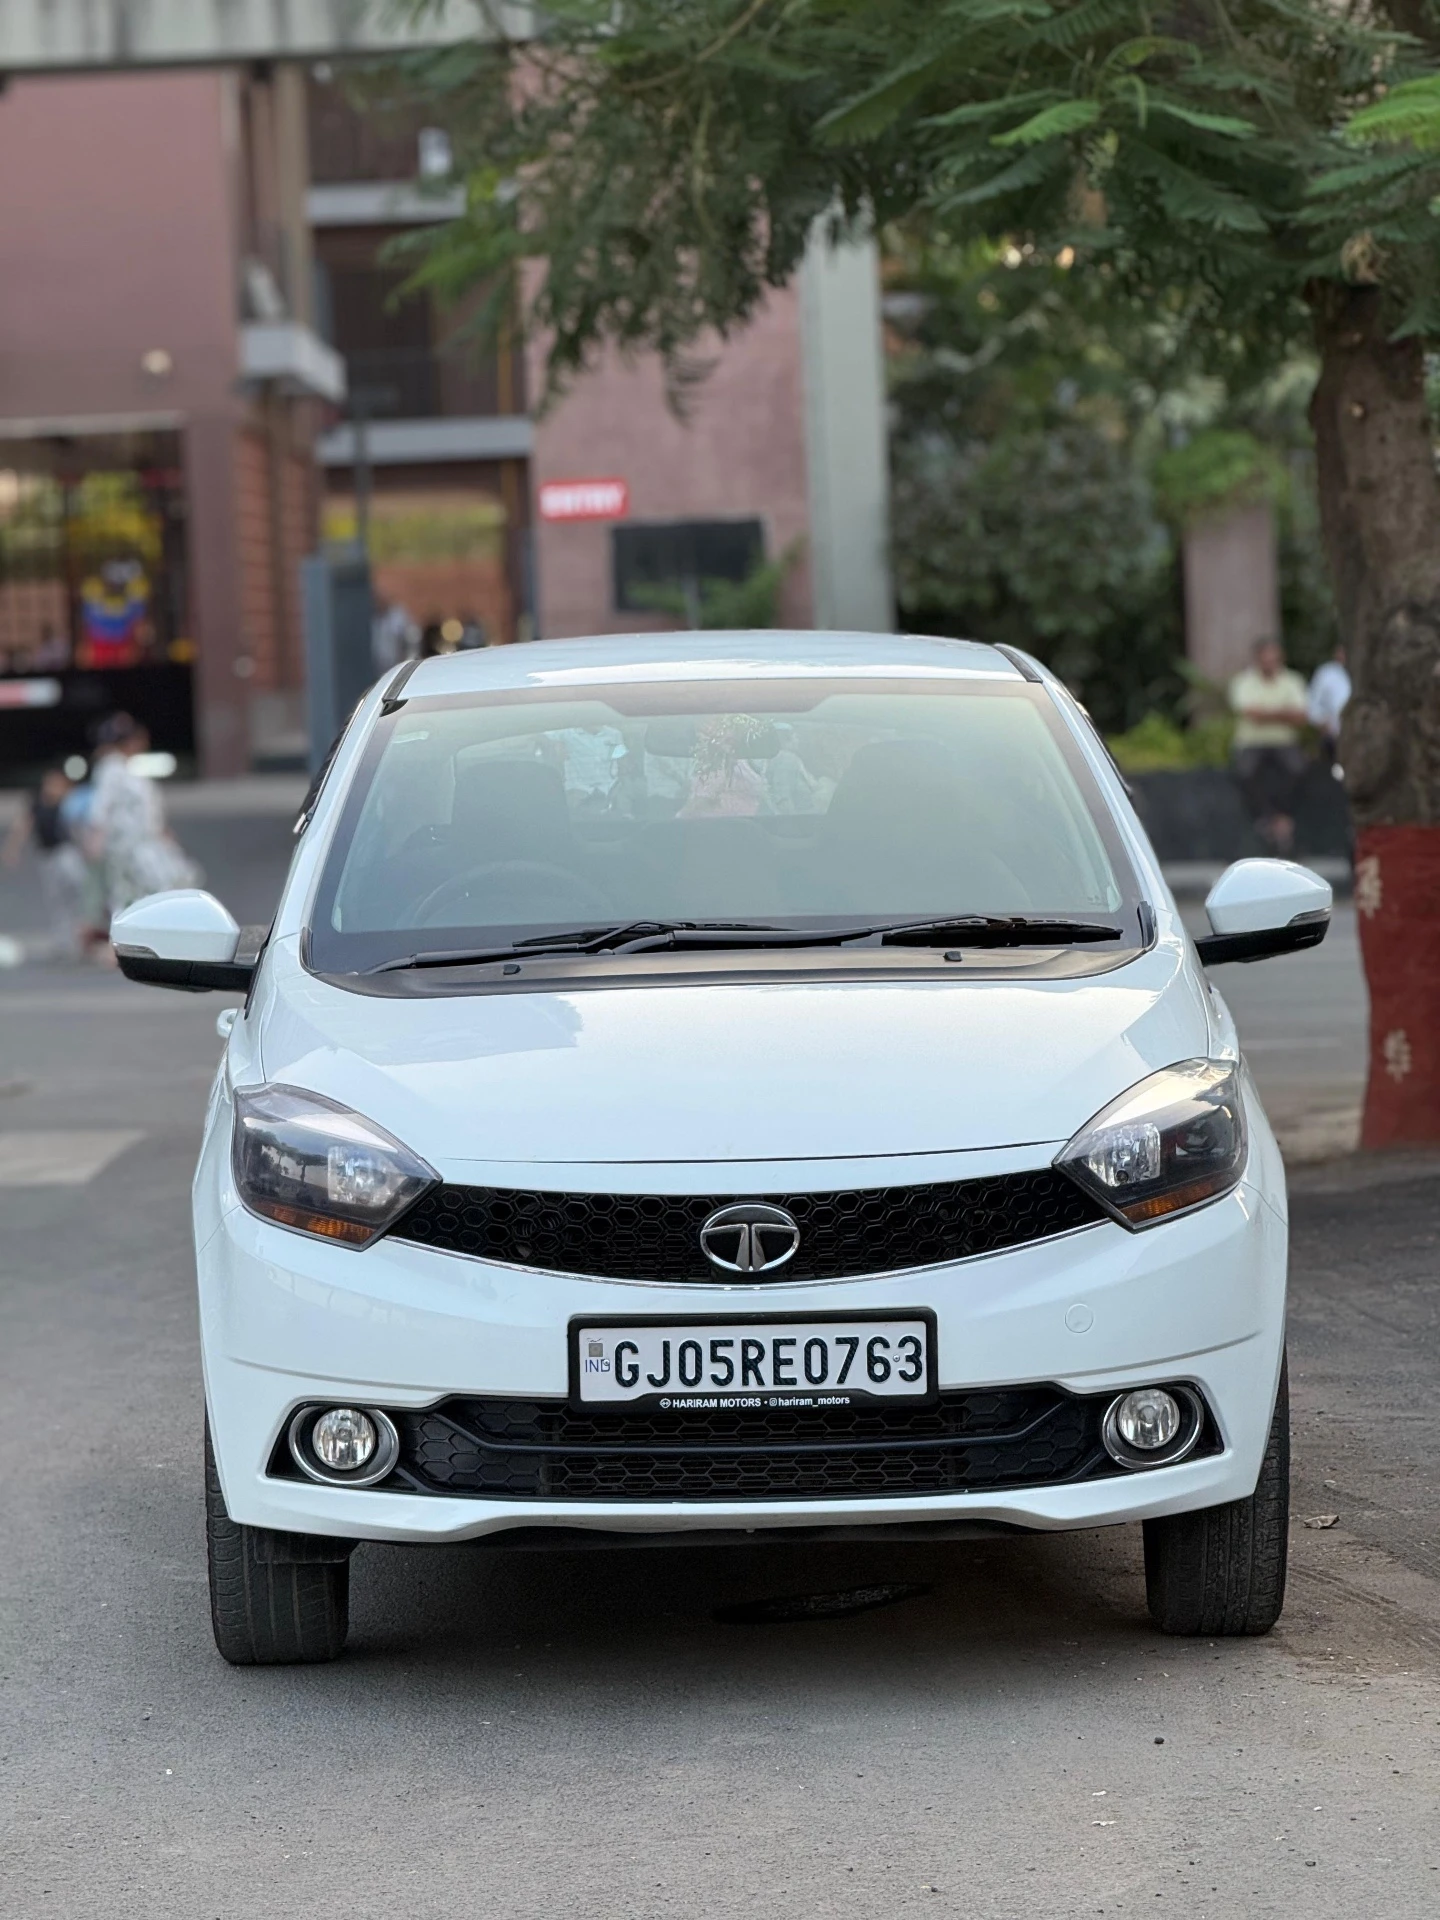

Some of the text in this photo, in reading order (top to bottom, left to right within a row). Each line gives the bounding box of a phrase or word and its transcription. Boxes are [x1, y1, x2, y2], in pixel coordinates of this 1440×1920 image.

[614, 1336, 923, 1388] GJ05RE0763
[672, 1398, 718, 1409] HARIRAM
[719, 1397, 762, 1408] MOTORS
